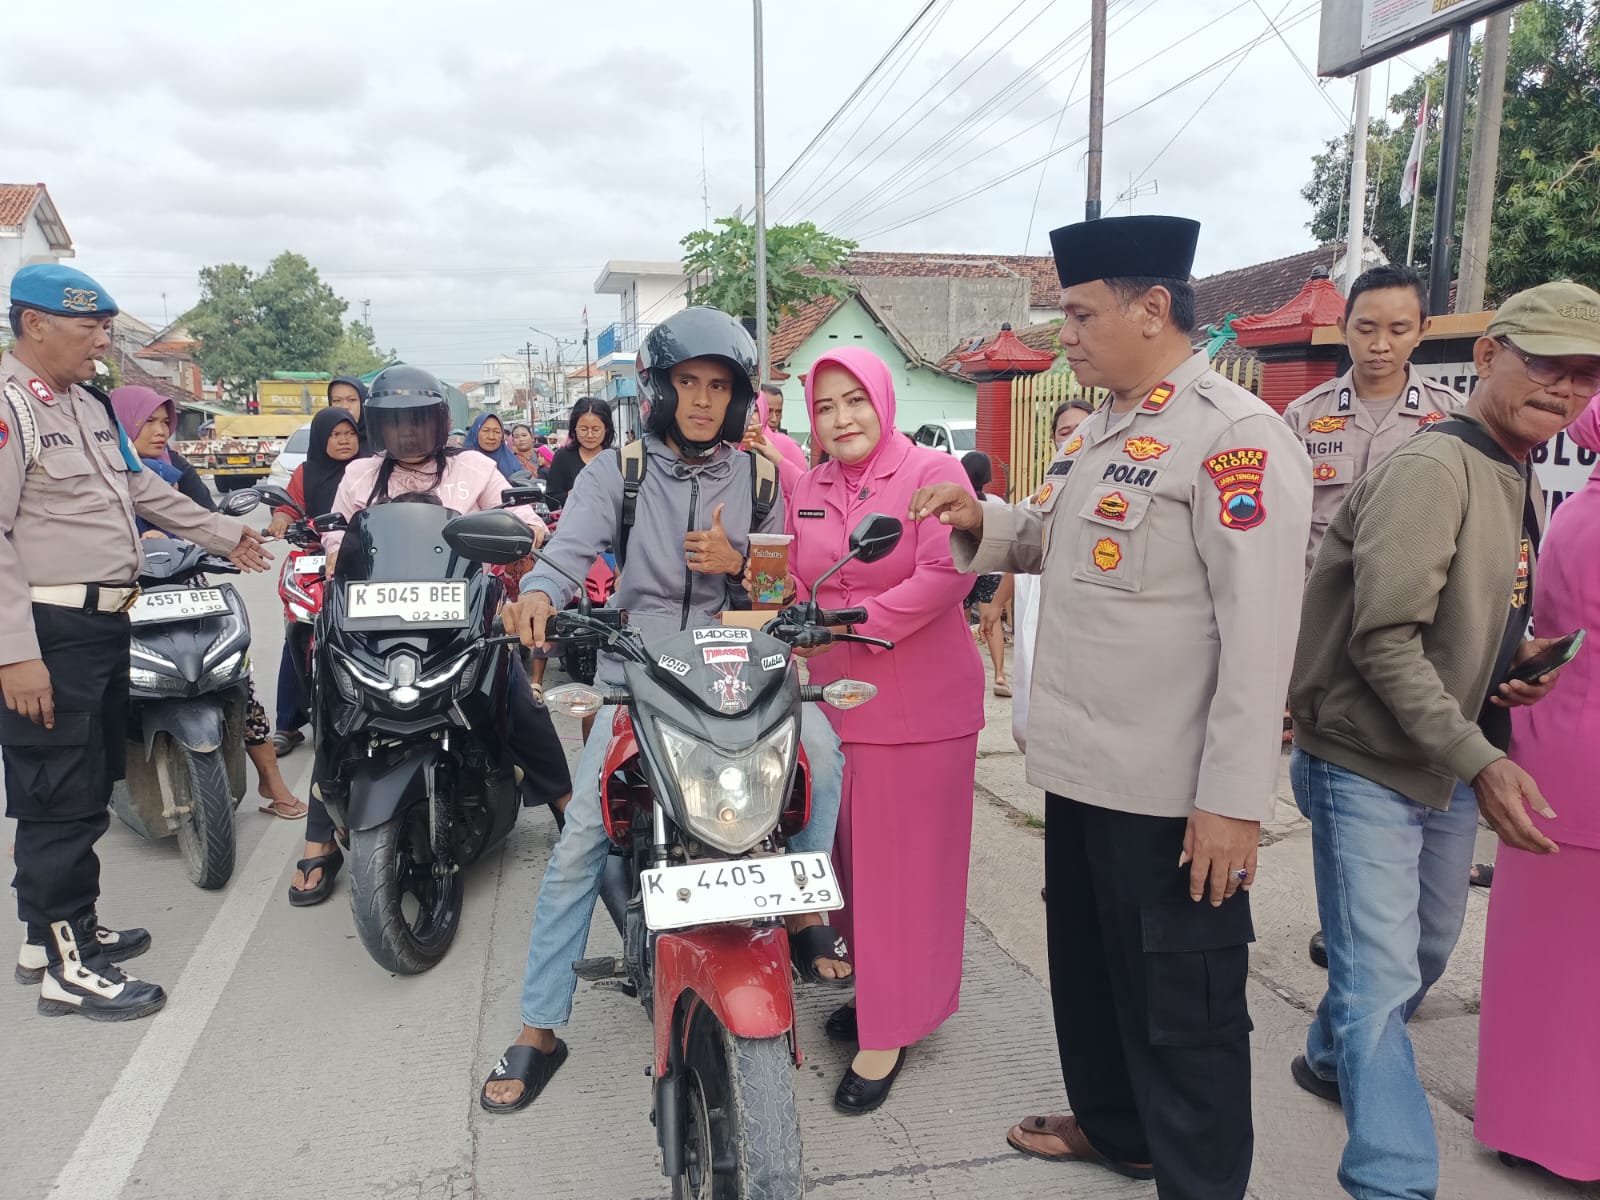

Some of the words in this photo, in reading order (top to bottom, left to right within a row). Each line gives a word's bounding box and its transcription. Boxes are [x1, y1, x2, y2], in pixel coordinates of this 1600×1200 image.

[1208, 450, 1263, 468] POLRES
[1214, 457, 1259, 472] BLORA
[1102, 463, 1158, 487] POLRI
[146, 593, 181, 607] 4557
[190, 591, 219, 602] BEE
[356, 589, 367, 605] K
[376, 587, 419, 604] 5045
[430, 586, 461, 602] BEE
[695, 630, 748, 640] BADGER
[648, 873, 664, 894] K
[697, 864, 766, 890] 4405
[790, 858, 827, 886] DJ
